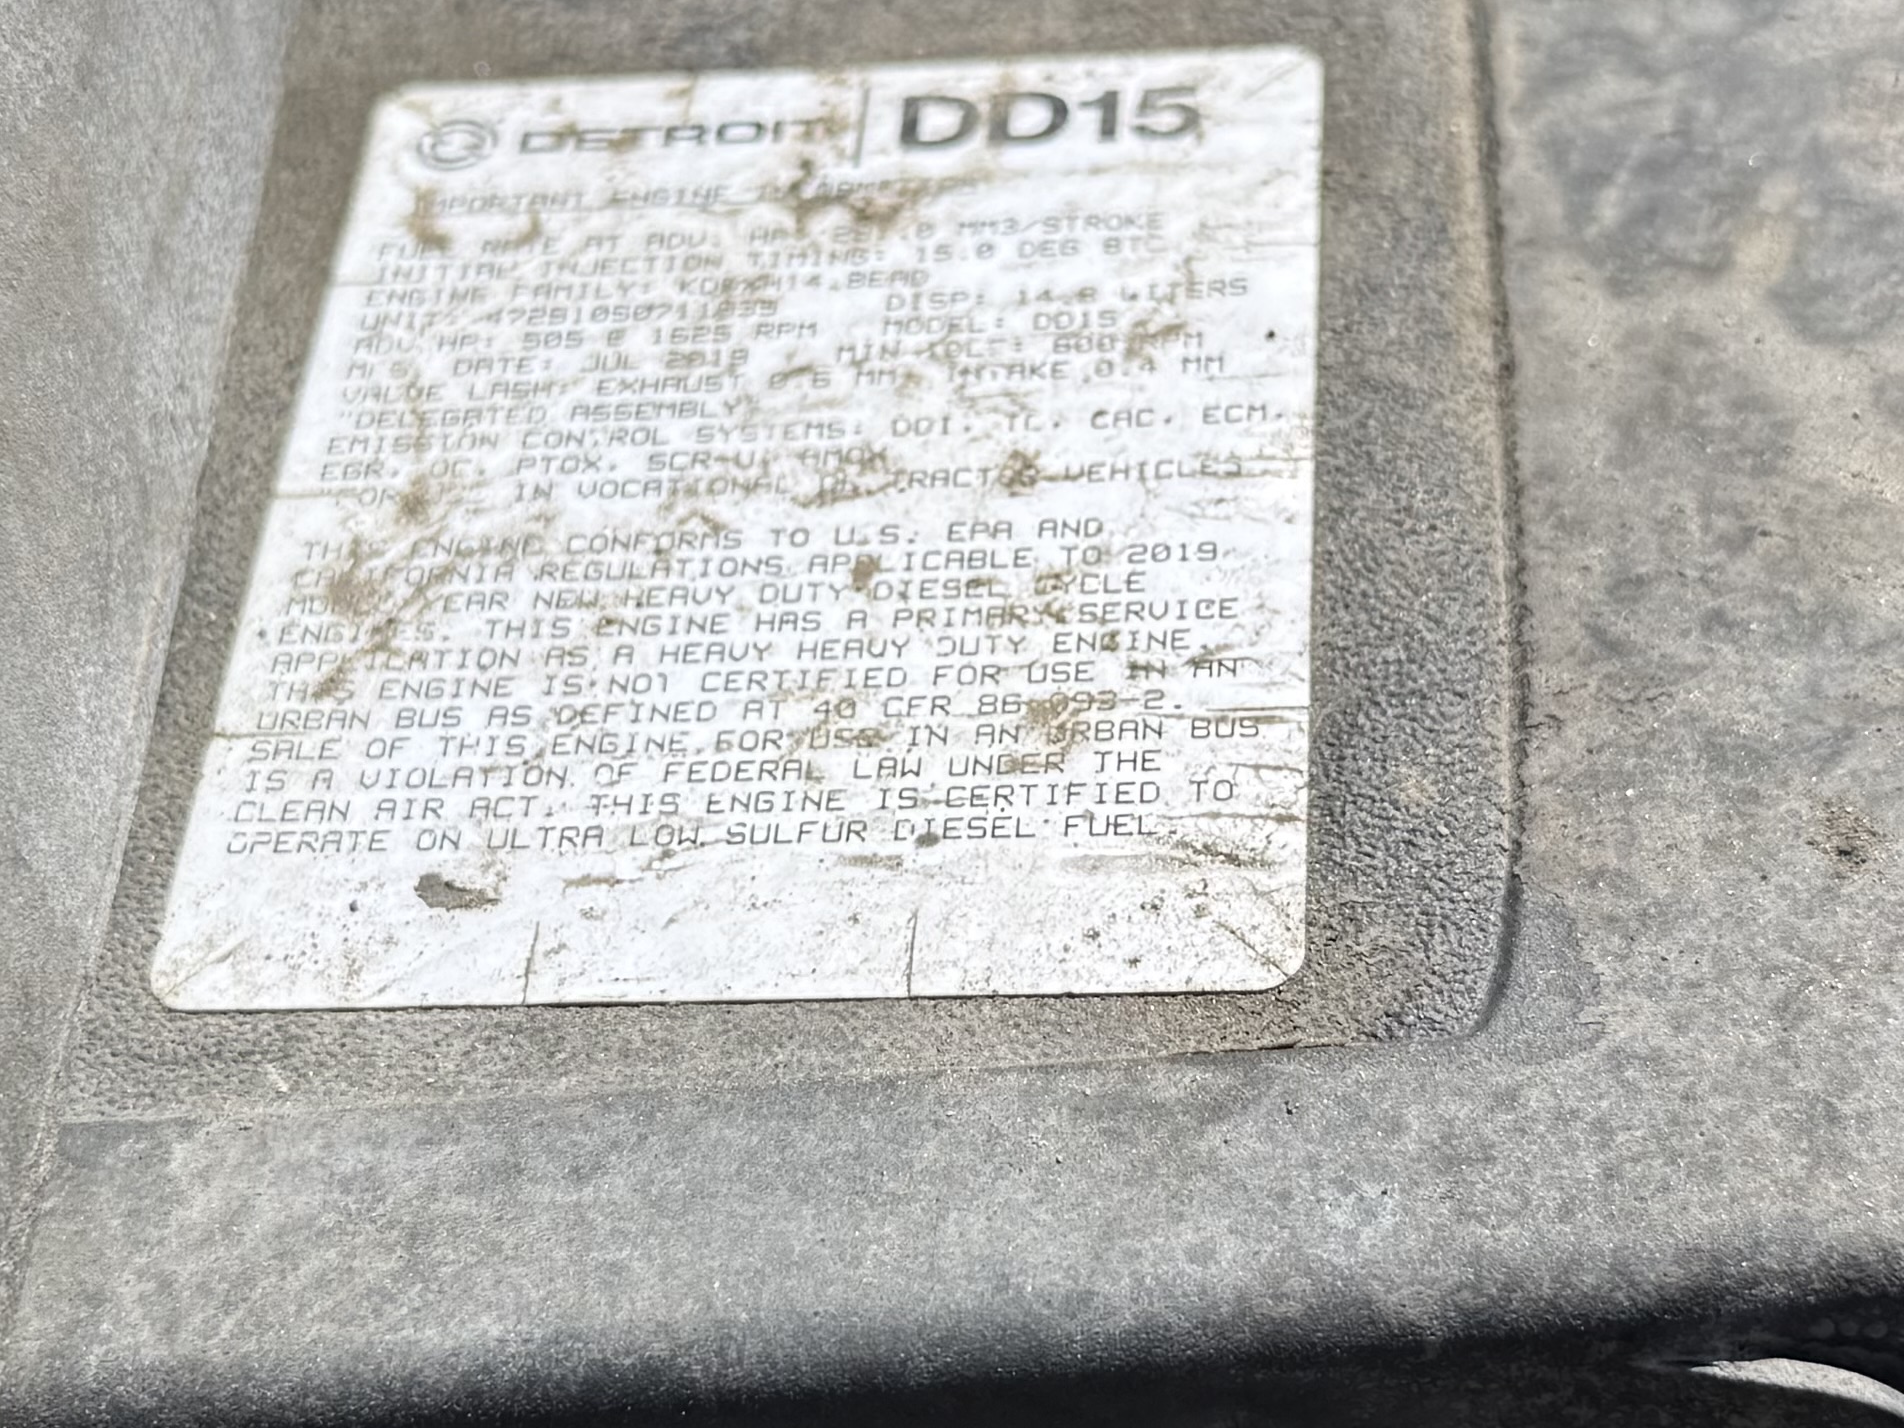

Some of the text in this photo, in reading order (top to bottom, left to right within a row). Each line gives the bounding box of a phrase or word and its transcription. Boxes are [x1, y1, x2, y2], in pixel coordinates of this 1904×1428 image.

[899, 86, 1200, 148] DD15
[417, 190, 584, 215] MPORTANT
[583, 234, 620, 253] AT
[916, 242, 995, 264] 15.0
[1017, 239, 1078, 260] DEG
[365, 286, 486, 308] ENGINE
[512, 279, 649, 302] FAMILY:
[885, 289, 985, 313] DISP:
[1120, 277, 1250, 303] LITERS
[436, 333, 493, 351] HP:
[522, 330, 583, 352] 505
[651, 323, 732, 346] 1625
[753, 320, 818, 341] RPM
[882, 313, 1004, 337] MODEL:
[452, 355, 553, 378] DATE:
[580, 351, 640, 374] JUL
[836, 341, 900, 365] MIN
[1052, 332, 1117, 355] 600
[342, 383, 443, 405] VALVE
[596, 373, 744, 397] EXHAUST
[948, 359, 1070, 384] INTAKE
[1181, 354, 1225, 375] MM
[327, 433, 499, 457] EMISSION
[696, 421, 862, 446] SYSTEMS:
[515, 479, 555, 503] IN
[576, 473, 794, 500] VOCATIONAL
[892, 464, 1038, 490] TRACTO
[303, 538, 388, 562] THS
[567, 529, 744, 556] CONFORMS
[770, 527, 811, 549] TO
[834, 523, 919, 547] U.S.
[947, 519, 1014, 542] EPA
[1037, 517, 1104, 540] AND
[292, 540, 1219, 591] CAIFORNIA REGULATIONS APLICABLE TO 2019
[532, 589, 600, 612] NEW
[622, 584, 737, 610] HEAVY
[759, 580, 849, 605] DUTY
[872, 575, 1010, 602] DIESEL
[278, 596, 1240, 645] ENGIES. THIS ENGINE HAS A PRIMARY SERVICE
[544, 645, 591, 668] AS
[613, 643, 636, 666] A
[659, 640, 774, 665] HEAVY
[796, 636, 911, 661] HEAVY
[936, 633, 1028, 658] DUTY
[267, 679, 358, 704] THS
[377, 675, 517, 701] ENGINE
[542, 673, 585, 697] IS
[700, 666, 908, 693] CERTIFIED
[932, 663, 1003, 687] FOR
[1027, 659, 1098, 685] USE
[1125, 658, 1168, 681] IN
[1192, 658, 1240, 679] AN
[256, 688, 1183, 732] URBAN BUS AS DEFINED AT 40 CFR 86093-2.
[245, 735, 344, 763] SALE
[364, 734, 414, 761] OF
[438, 733, 528, 758] THIS
[550, 730, 691, 756] ENGINE
[907, 723, 950, 748] IN
[973, 722, 1020, 747] AN
[1047, 717, 1165, 745] URBAN
[1190, 715, 1261, 741] BUS
[244, 768, 290, 793] IS
[311, 766, 335, 792] A
[593, 760, 641, 788] OF
[662, 757, 825, 784] FEDERAL
[851, 754, 923, 780] LAW
[947, 750, 1066, 778] UNDER
[1093, 747, 1163, 775] THE
[233, 798, 352, 824] CLEAN
[373, 795, 446, 822] AIR
[590, 790, 682, 817] THIS
[705, 786, 848, 815] ENGINE
[876, 785, 919, 812] IS
[944, 779, 1162, 809] CERTIFIED
[1187, 777, 1236, 803] TO
[225, 812, 1178, 855] OPERATE ON ULTRA LOW SULFUR DIESEL FUEL.
